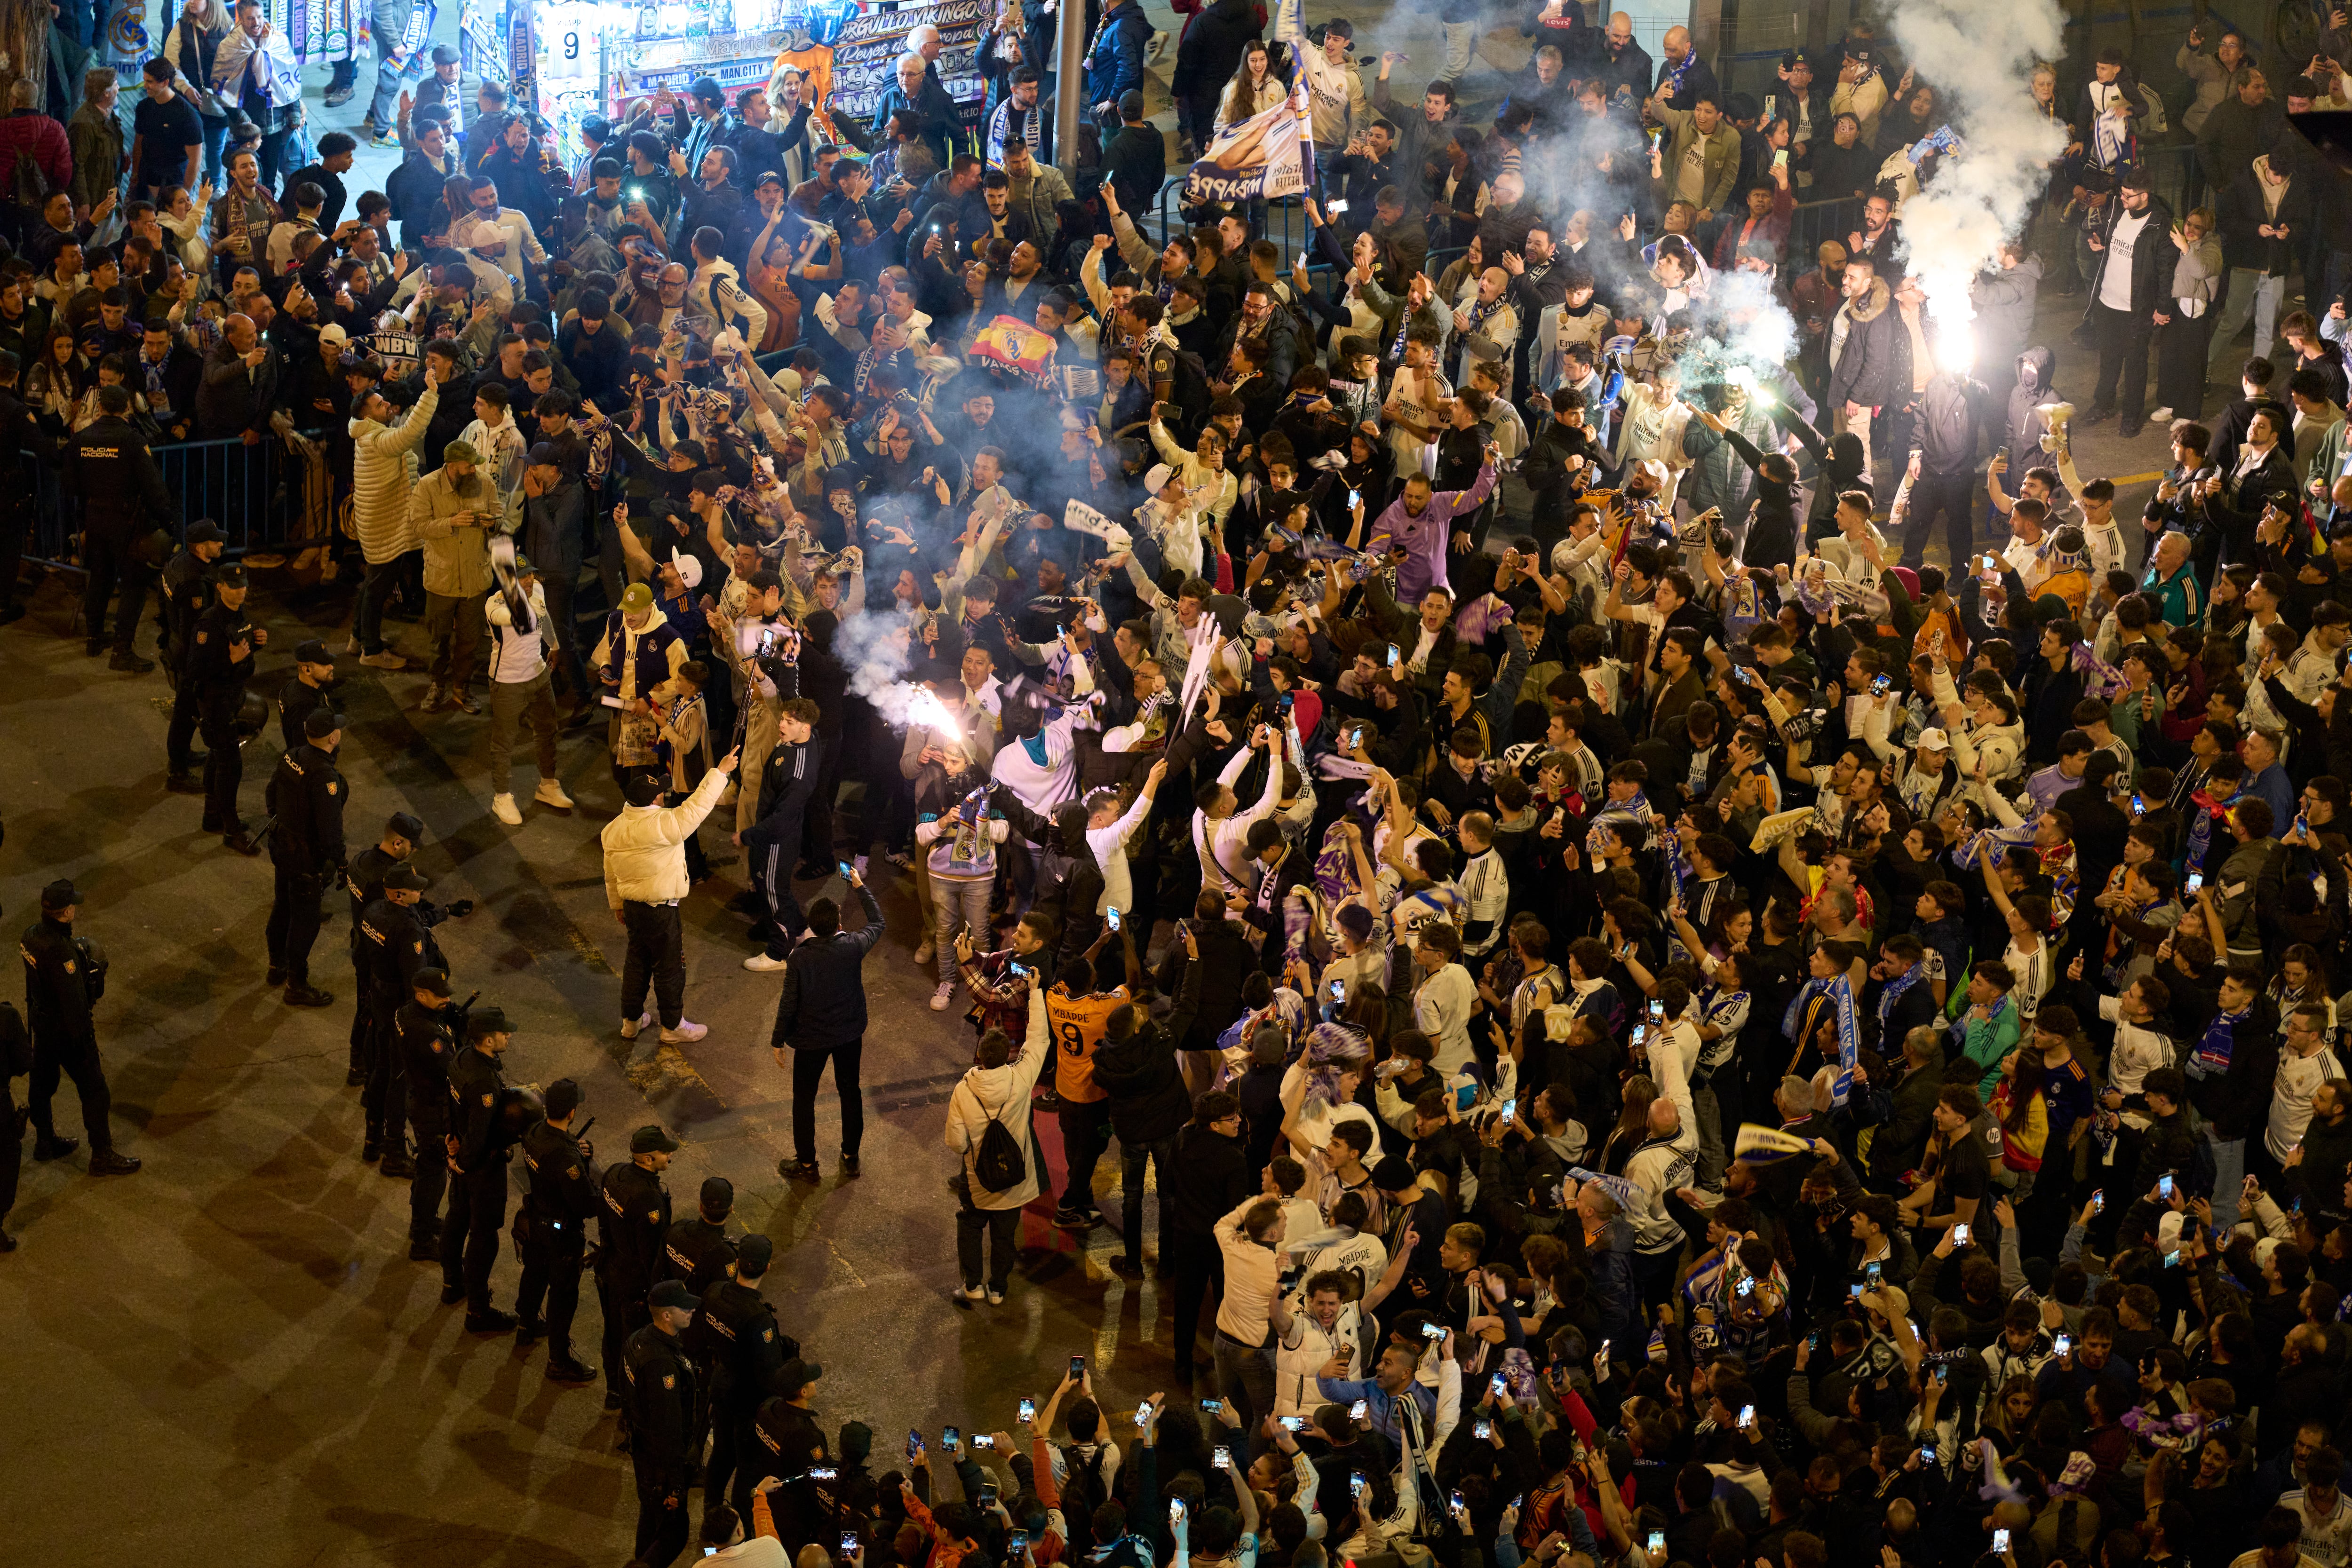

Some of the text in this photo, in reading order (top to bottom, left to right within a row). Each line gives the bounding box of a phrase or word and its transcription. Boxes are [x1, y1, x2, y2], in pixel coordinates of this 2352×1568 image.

[913, 2, 977, 27] VIKINGO
[515, 28, 527, 70] MADRID
[564, 32, 579, 59] 9
[659, 35, 766, 60] Real Madrid
[837, 27, 975, 65] Reyes de ropa
[648, 73, 689, 87] MADRID
[721, 64, 763, 79] MAN.CITY
[1634, 421, 1661, 441] mirates
[284, 754, 301, 772] POLICIA
[1587, 781, 1599, 797] hp
[1282, 826, 1297, 840] RDA
[362, 920, 377, 935] POLICIA
[362, 925, 384, 946] NACIONAL
[1932, 958, 1942, 972] hp
[2024, 995, 2036, 1011] hp
[1052, 1007, 1090, 1023] MBAPPÉ
[1062, 1022, 1083, 1057] 9
[1989, 1129, 1999, 1143] hp
[666, 1244, 686, 1262] POLICIA
[1338, 1247, 1370, 1266] MBAPPÉ
[706, 1312, 727, 1328] POLICIA
[706, 1317, 735, 1342] NACIONAL
[755, 1423, 772, 1441] POLICIA
[755, 1428, 779, 1455] NACIONAL
[2300, 1537, 2336, 1552] mirates
